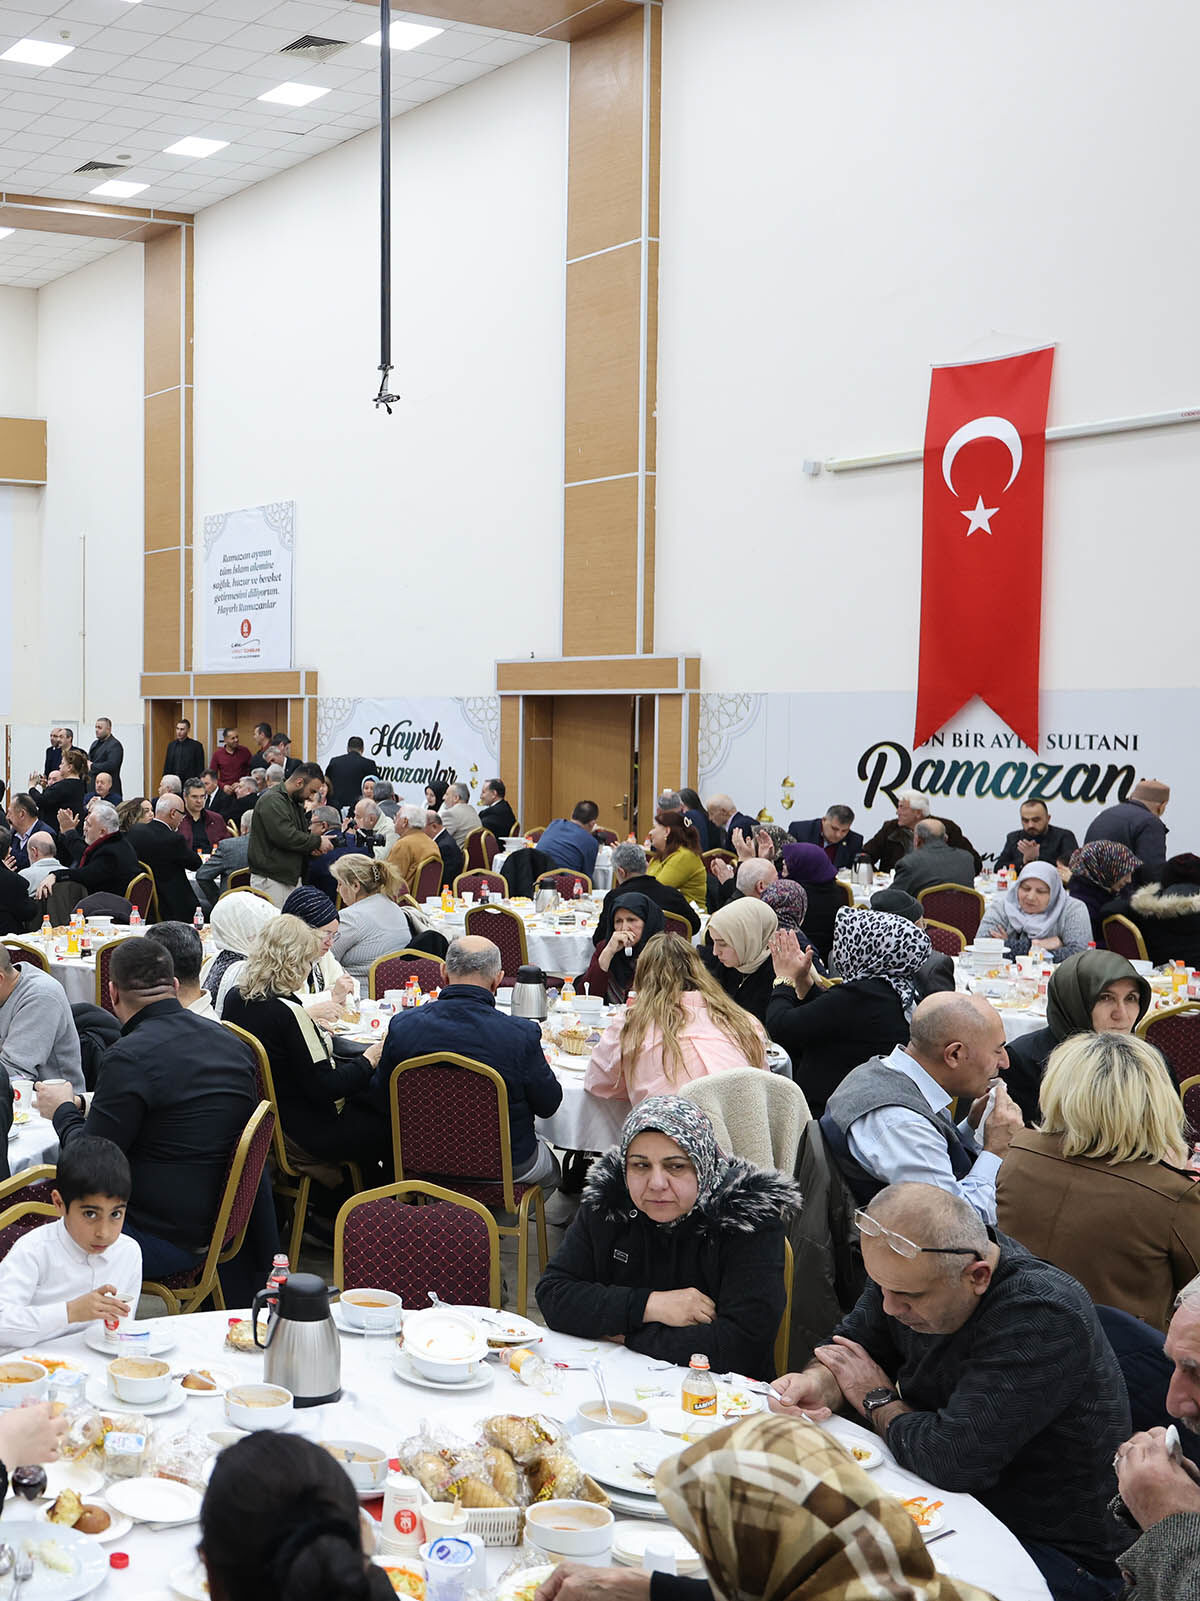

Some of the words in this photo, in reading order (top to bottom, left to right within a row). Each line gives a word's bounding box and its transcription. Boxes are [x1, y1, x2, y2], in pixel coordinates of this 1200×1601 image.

[222, 552, 250, 563] Ramazan
[259, 572, 281, 583] bereket
[239, 600, 277, 611] Ramazanlar
[369, 720, 443, 761] Hayırlı
[952, 729, 985, 748] BİR
[990, 733, 1029, 749] AYI
[1046, 733, 1139, 751] SULTANI
[376, 760, 458, 785] amazanlar
[857, 741, 1136, 809] Ramazan
